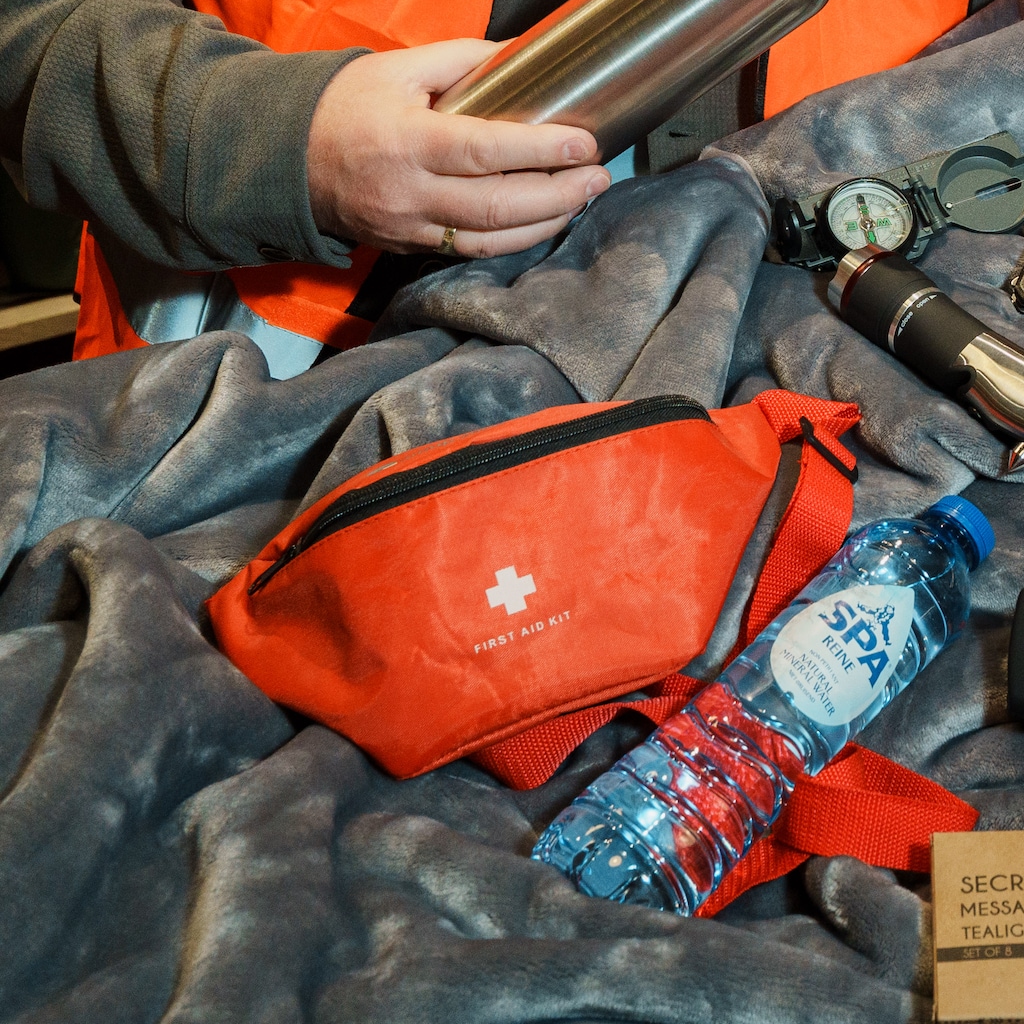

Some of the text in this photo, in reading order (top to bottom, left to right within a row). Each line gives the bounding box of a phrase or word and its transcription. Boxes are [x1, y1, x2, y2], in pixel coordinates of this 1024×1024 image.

[473, 610, 571, 654] FIRST AID KIT
[818, 599, 890, 689] SPA
[800, 653, 833, 695] NATURAL
[821, 634, 856, 675] REINE
[780, 649, 836, 717] MINERAL WATER
[963, 946, 1013, 959] SET OF 8
